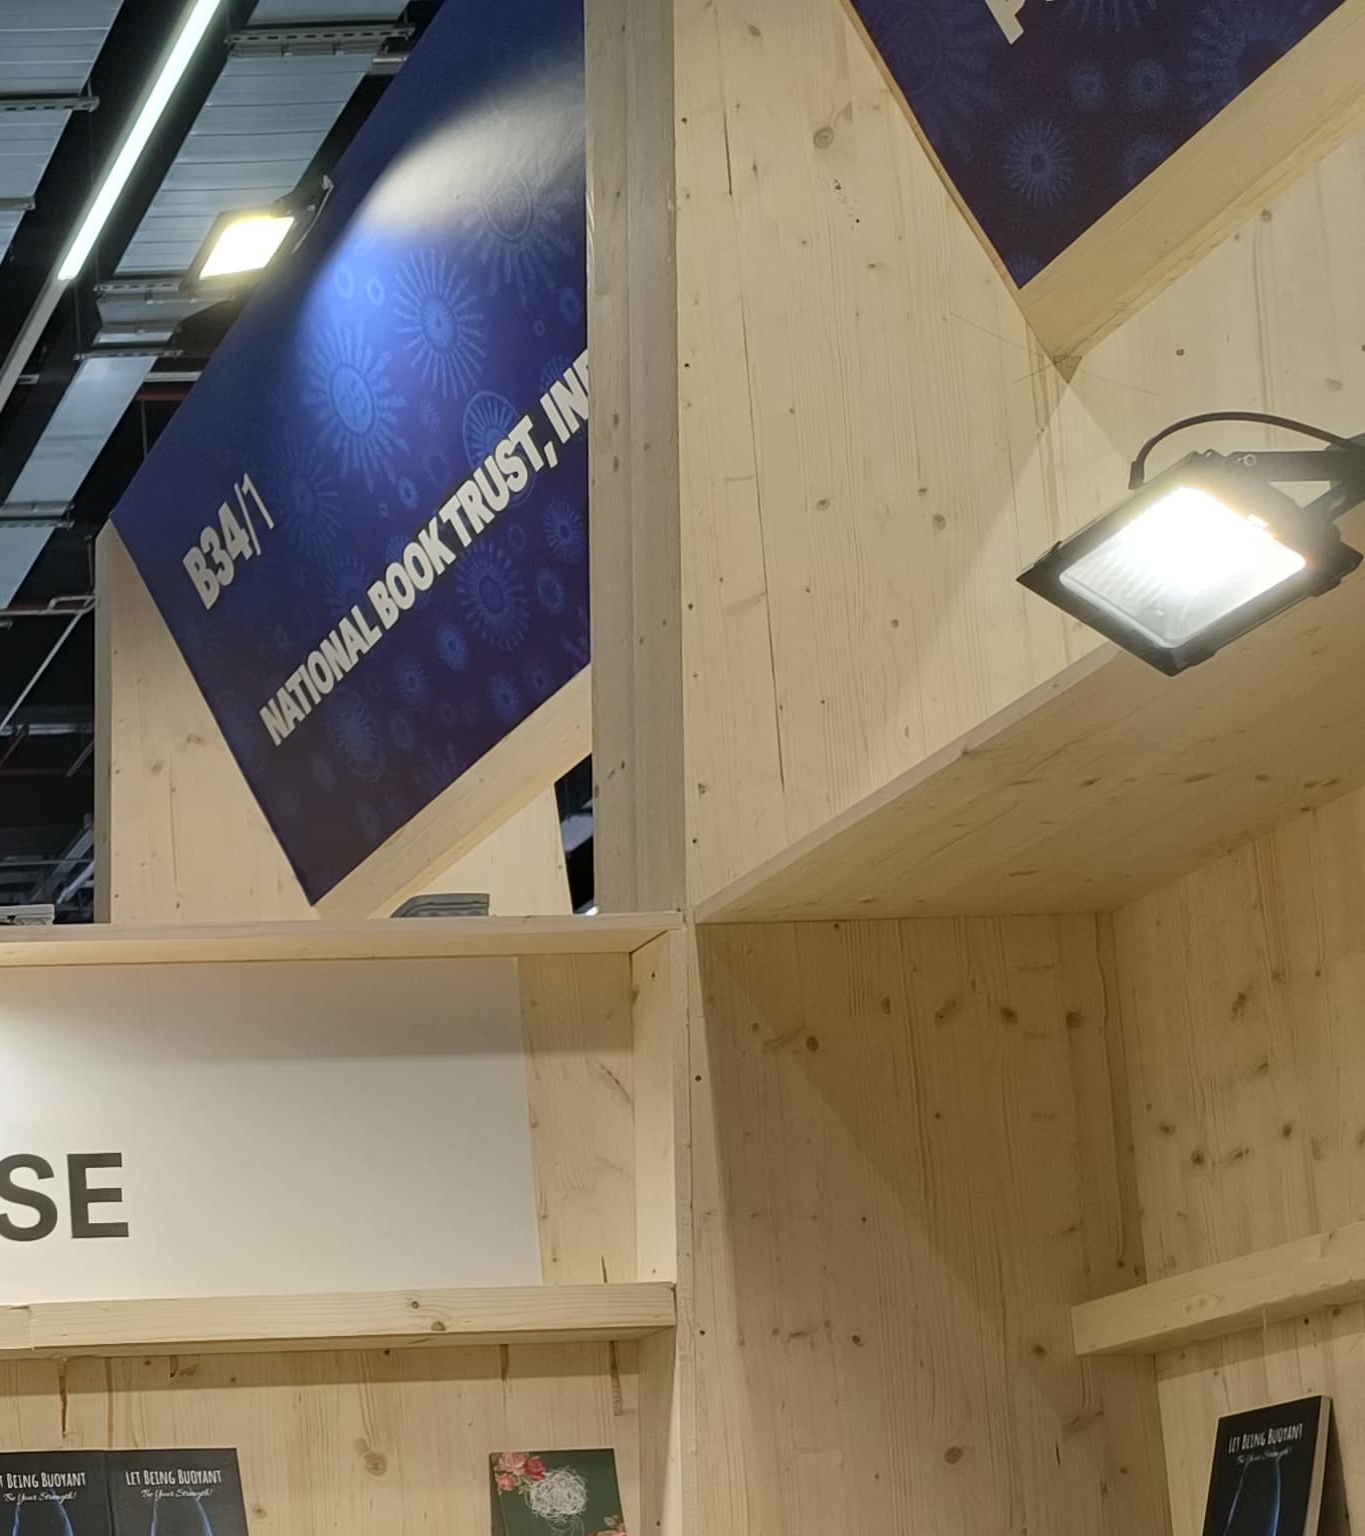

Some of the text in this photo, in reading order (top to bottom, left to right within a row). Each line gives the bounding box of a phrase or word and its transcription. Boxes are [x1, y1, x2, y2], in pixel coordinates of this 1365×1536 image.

[183, 473, 274, 610] B34/1
[259, 605, 383, 746] NATIONAL
[367, 517, 456, 629] BOOK
[440, 415, 559, 548] TRUST,
